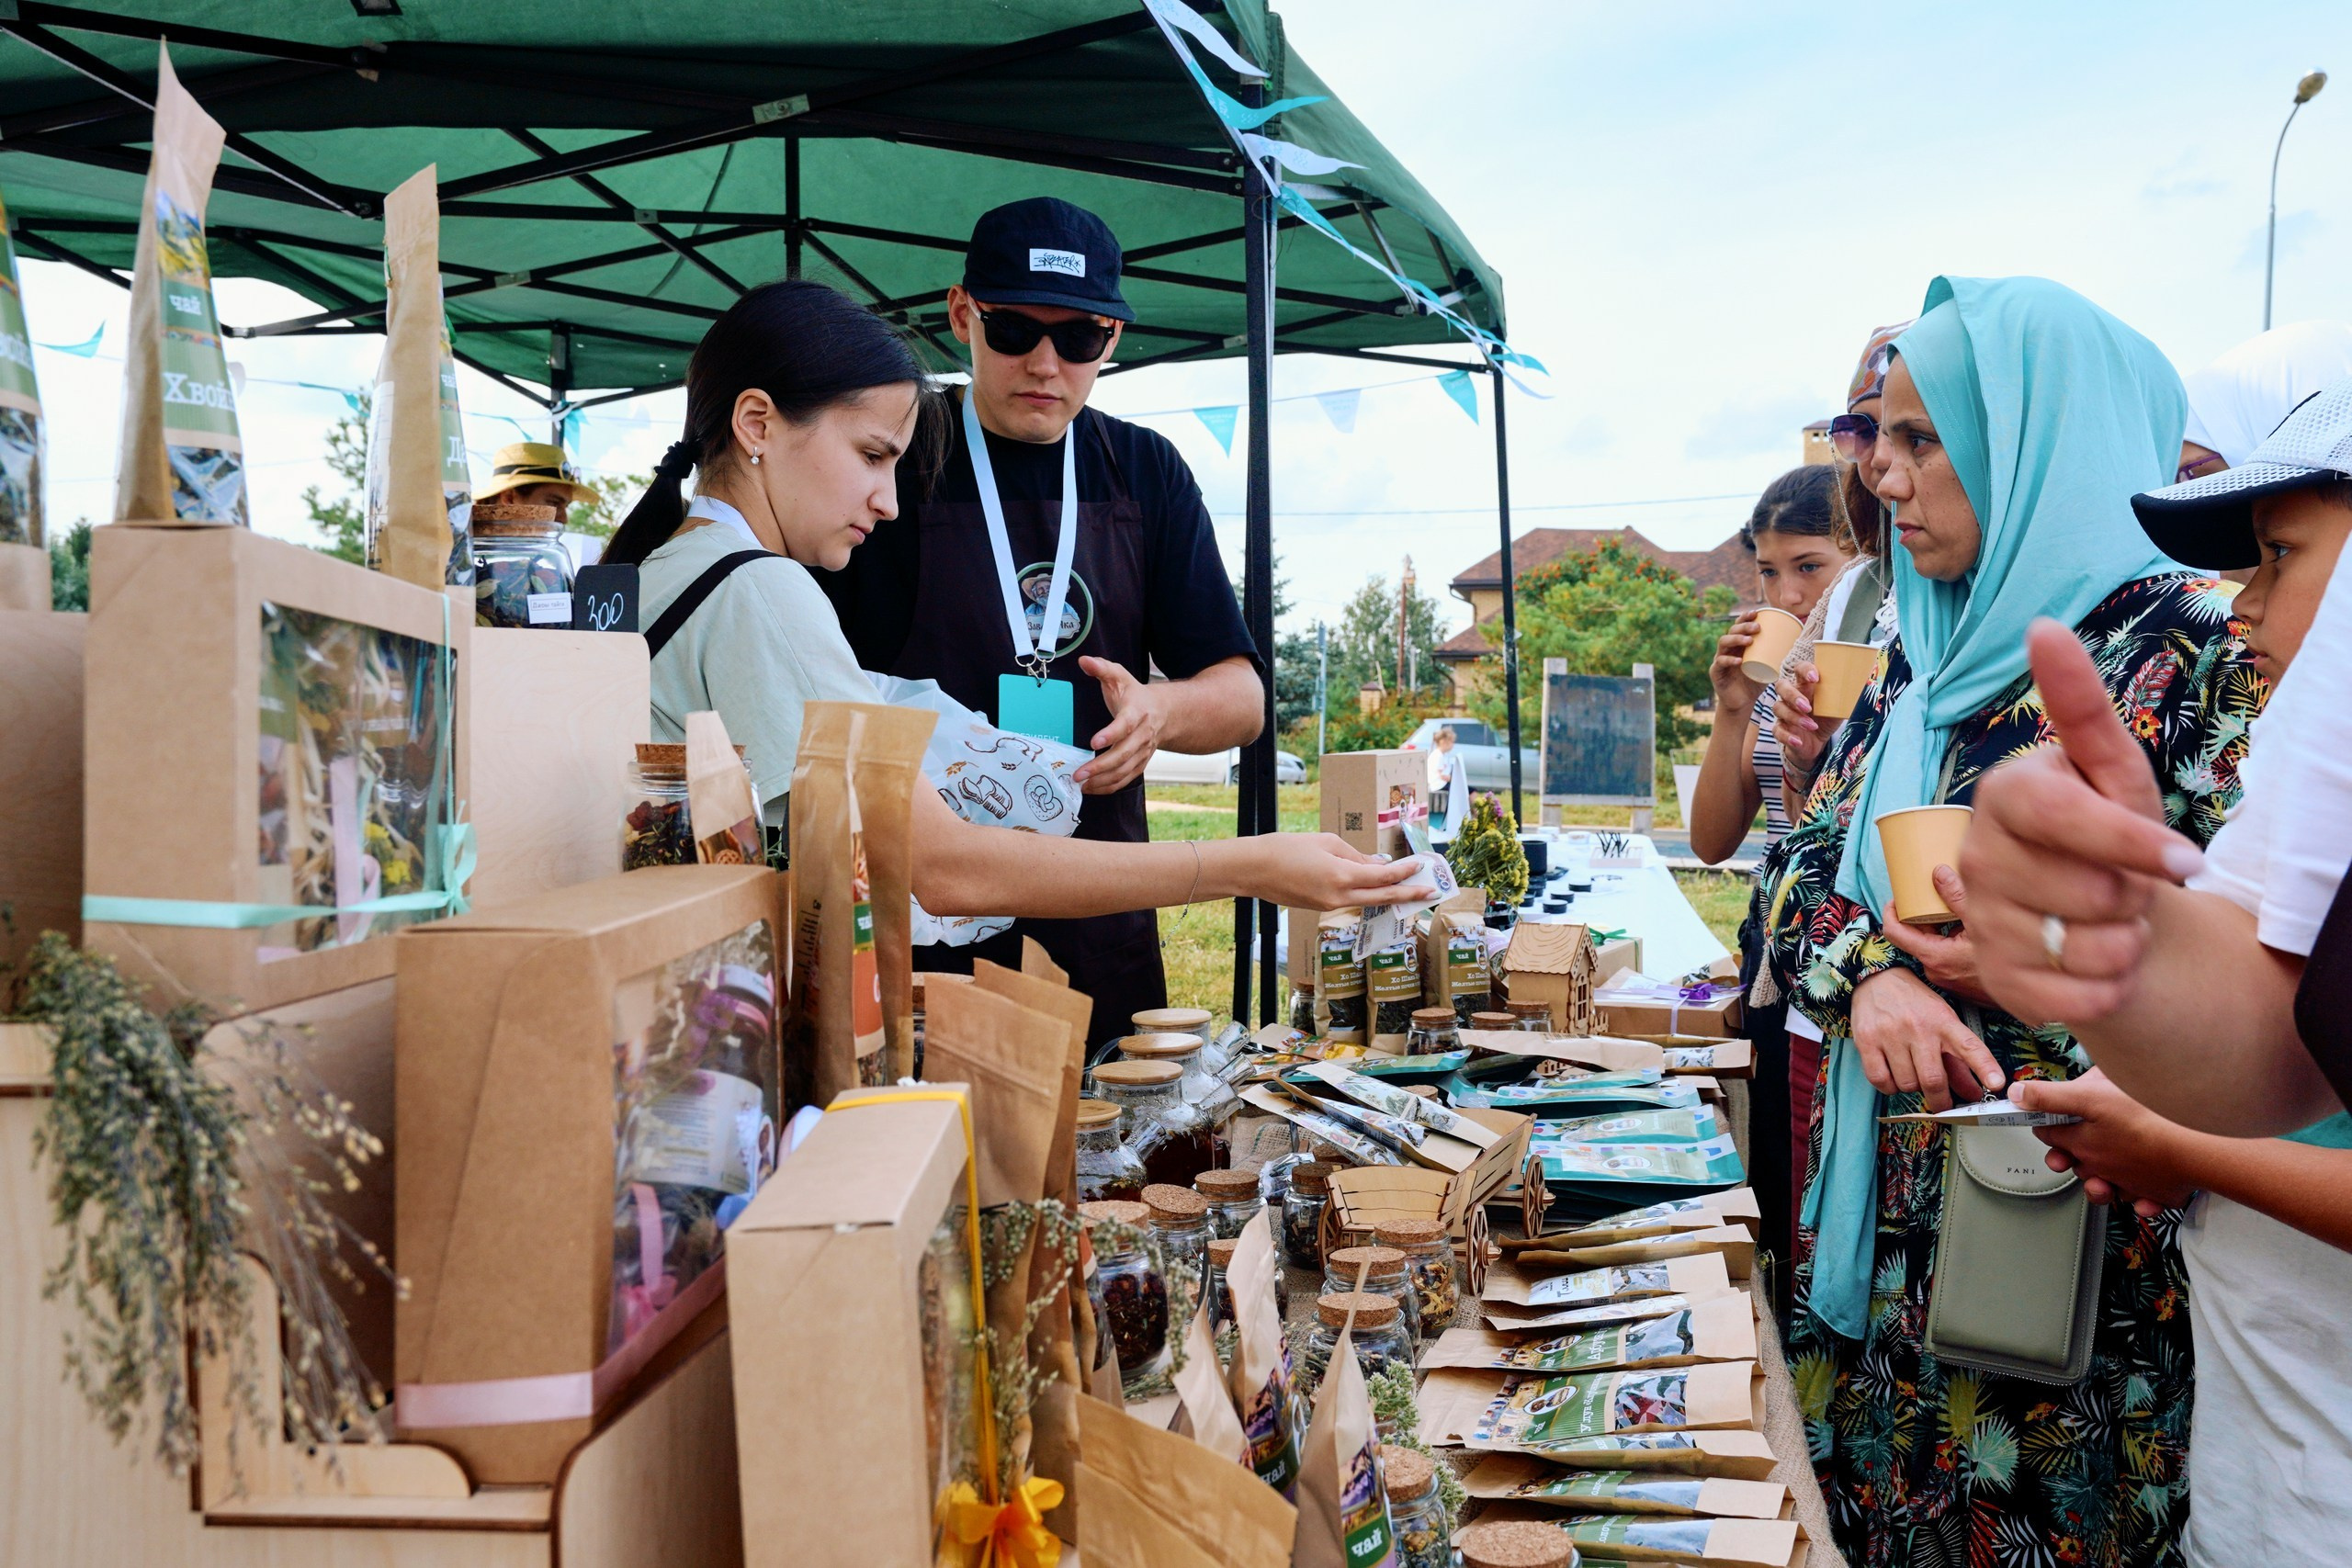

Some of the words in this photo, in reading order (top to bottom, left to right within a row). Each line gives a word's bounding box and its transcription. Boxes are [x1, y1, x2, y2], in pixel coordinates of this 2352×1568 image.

[168, 294, 202, 316] чай
[588, 592, 624, 631] 300
[1433, 865, 1452, 891] 500
[2007, 1167, 2036, 1175] FANI
[1351, 1528, 1383, 1558] чай
